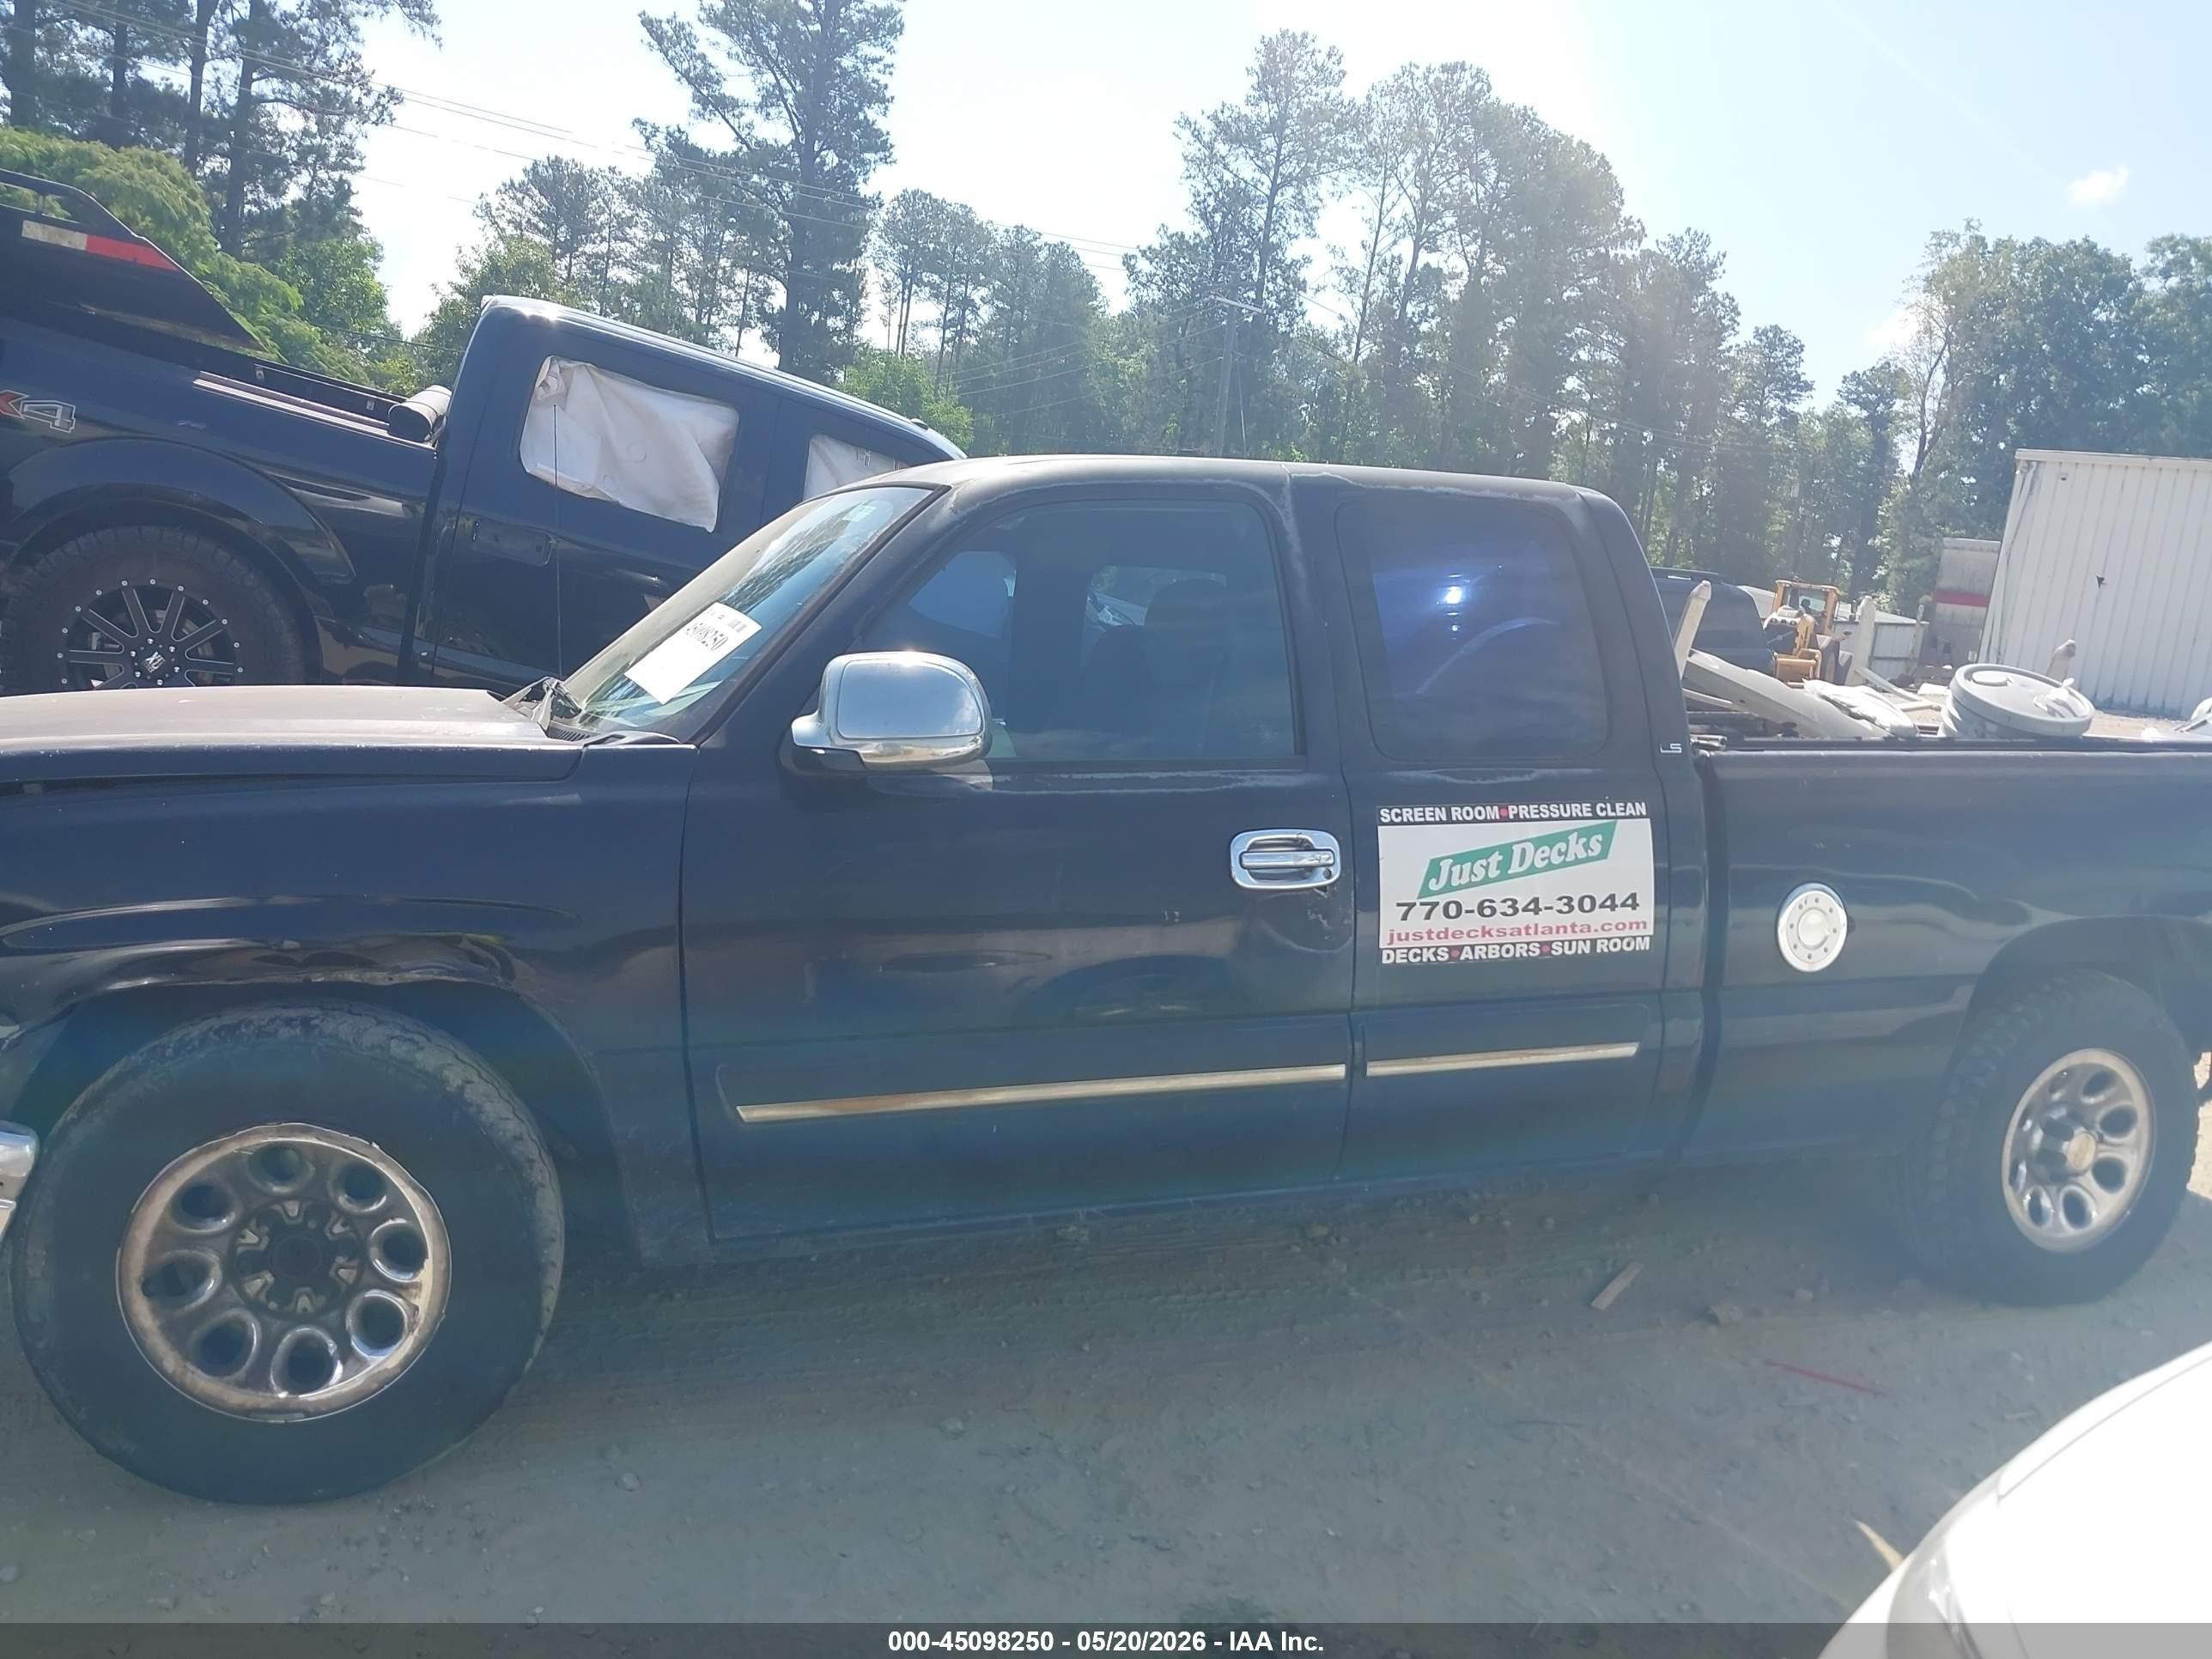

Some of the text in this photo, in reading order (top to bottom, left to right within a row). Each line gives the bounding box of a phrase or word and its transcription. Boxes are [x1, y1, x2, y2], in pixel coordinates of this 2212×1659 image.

[1660, 743, 1682, 753] LS
[1380, 802, 1647, 823] SCREEN ROOM PRESSURE CLEAN
[1428, 831, 1603, 890] Just Decks
[1395, 892, 1639, 921] 770-634-3044
[1387, 921, 1647, 945] justdecksatlanta.com
[1382, 936, 1650, 964] DECKS ARBORS SUN ROOM
